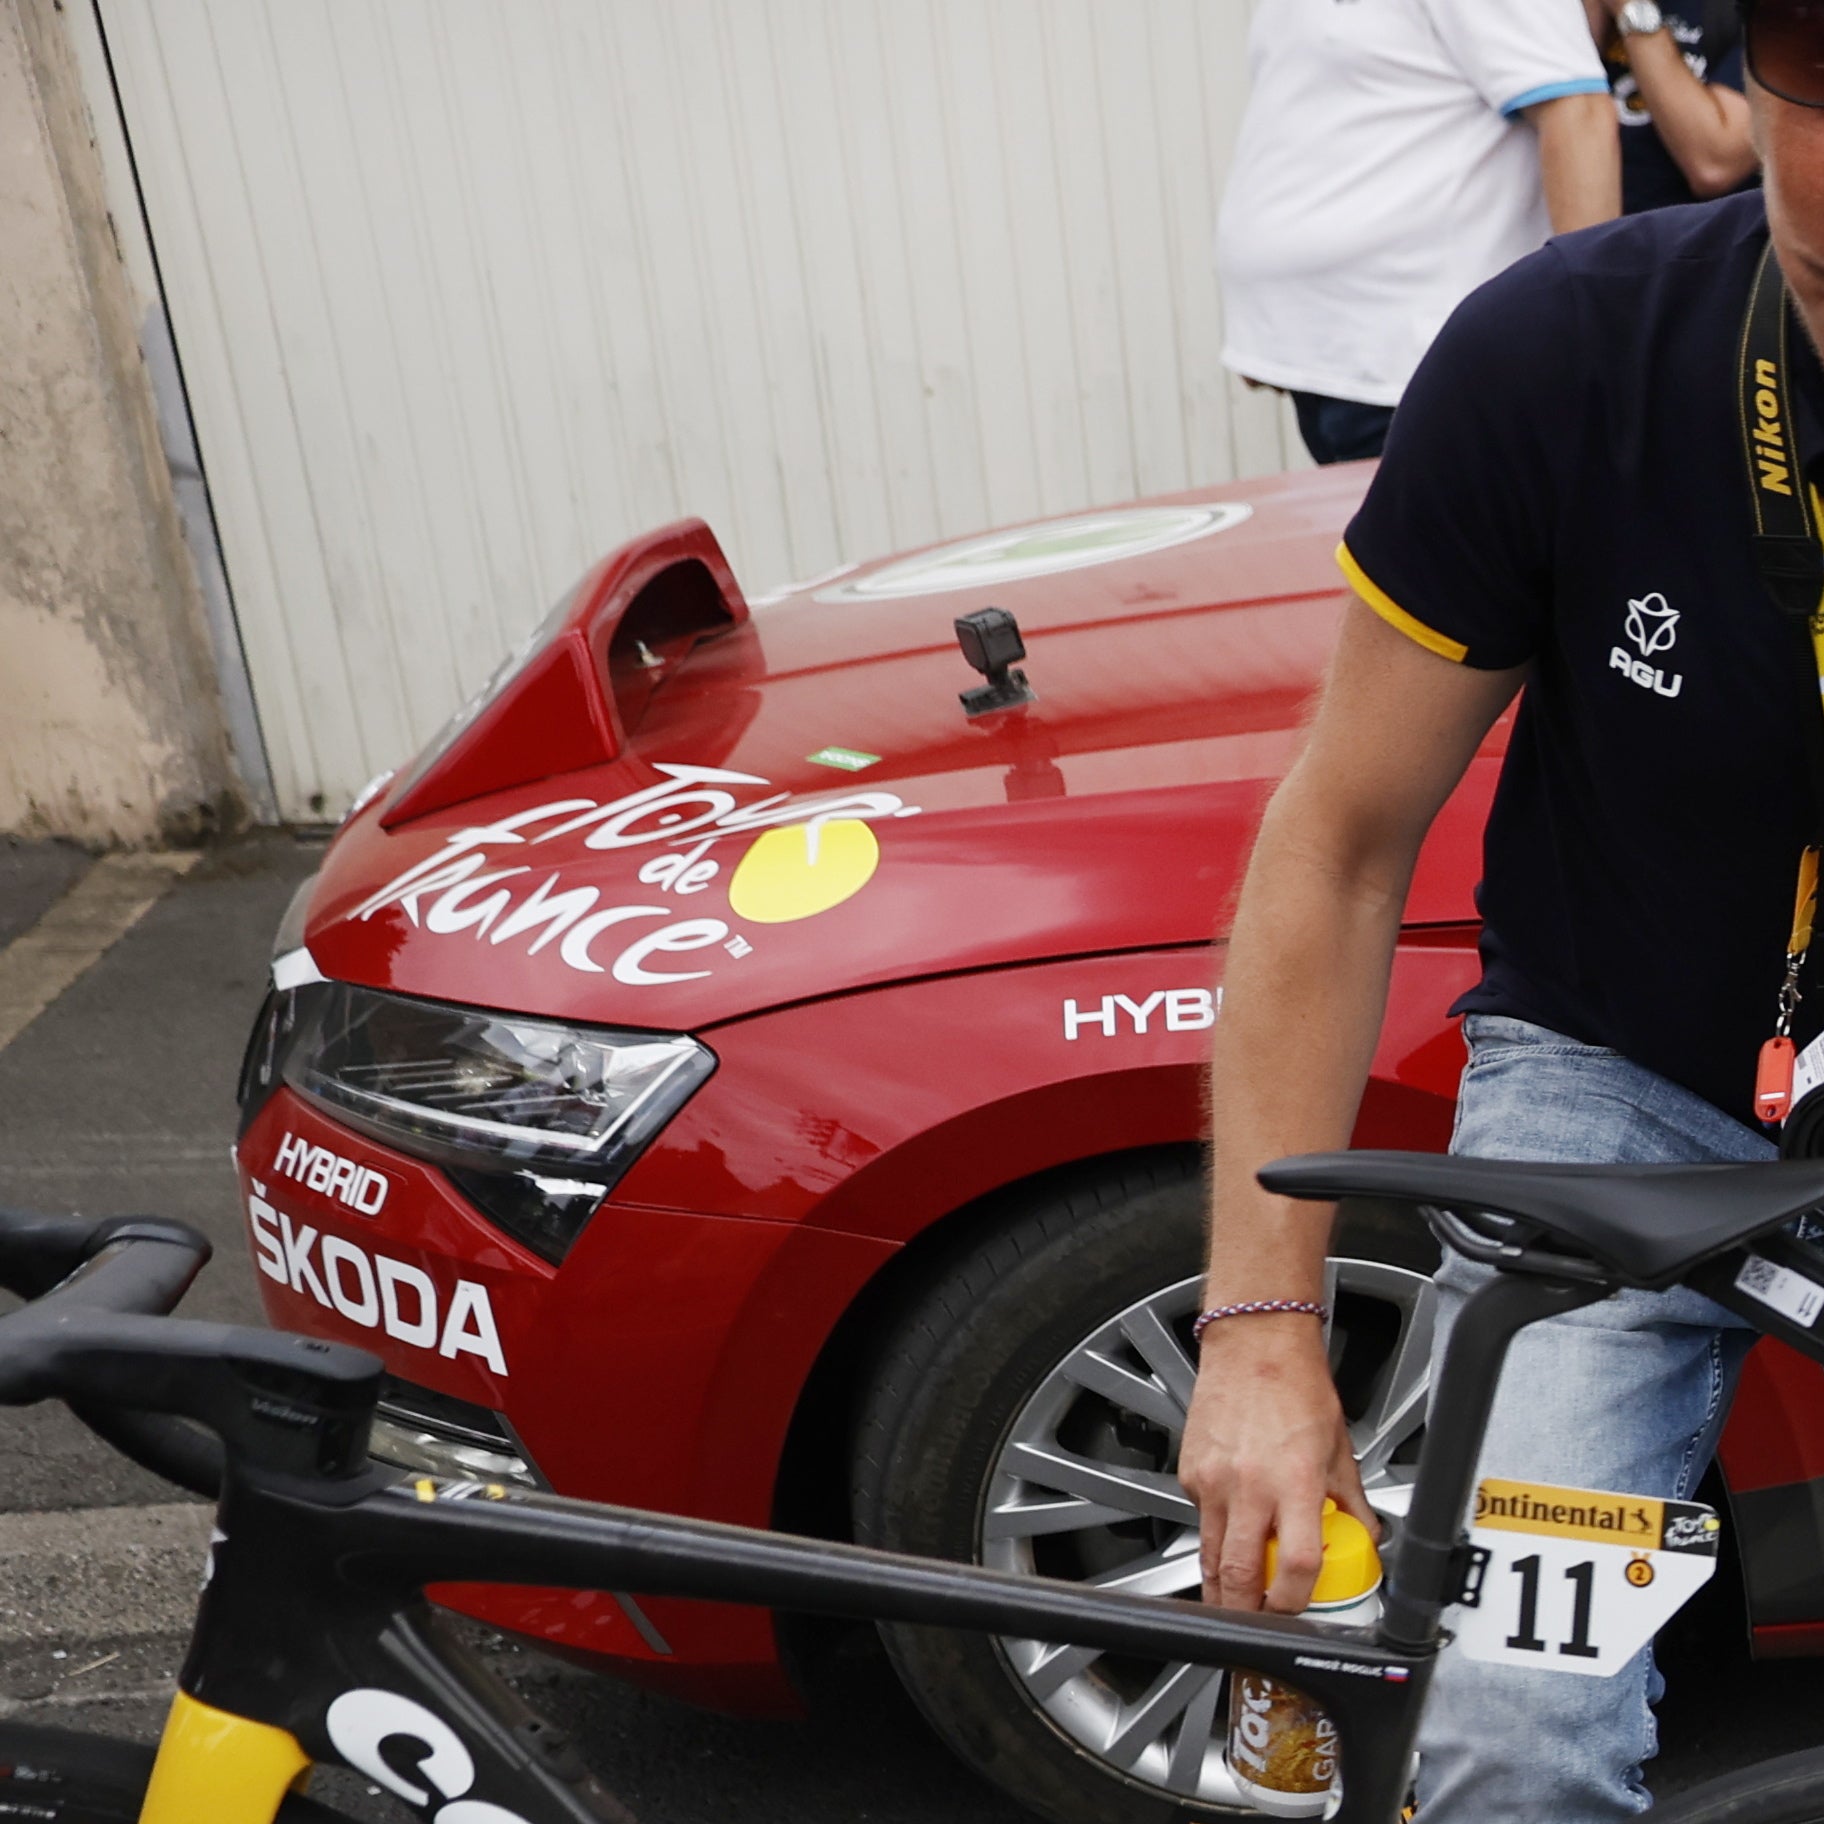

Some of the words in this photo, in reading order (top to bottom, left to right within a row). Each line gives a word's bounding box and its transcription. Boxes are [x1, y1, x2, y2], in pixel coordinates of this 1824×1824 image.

[1753, 358, 1793, 496] Nikon
[1609, 646, 1682, 698] AGU
[638, 840, 719, 895] de
[1063, 986, 1225, 1041] HYB
[272, 1130, 390, 1217] HYBRID
[248, 1180, 508, 1376] ŠKODA
[1505, 1553, 1600, 1659] 11
